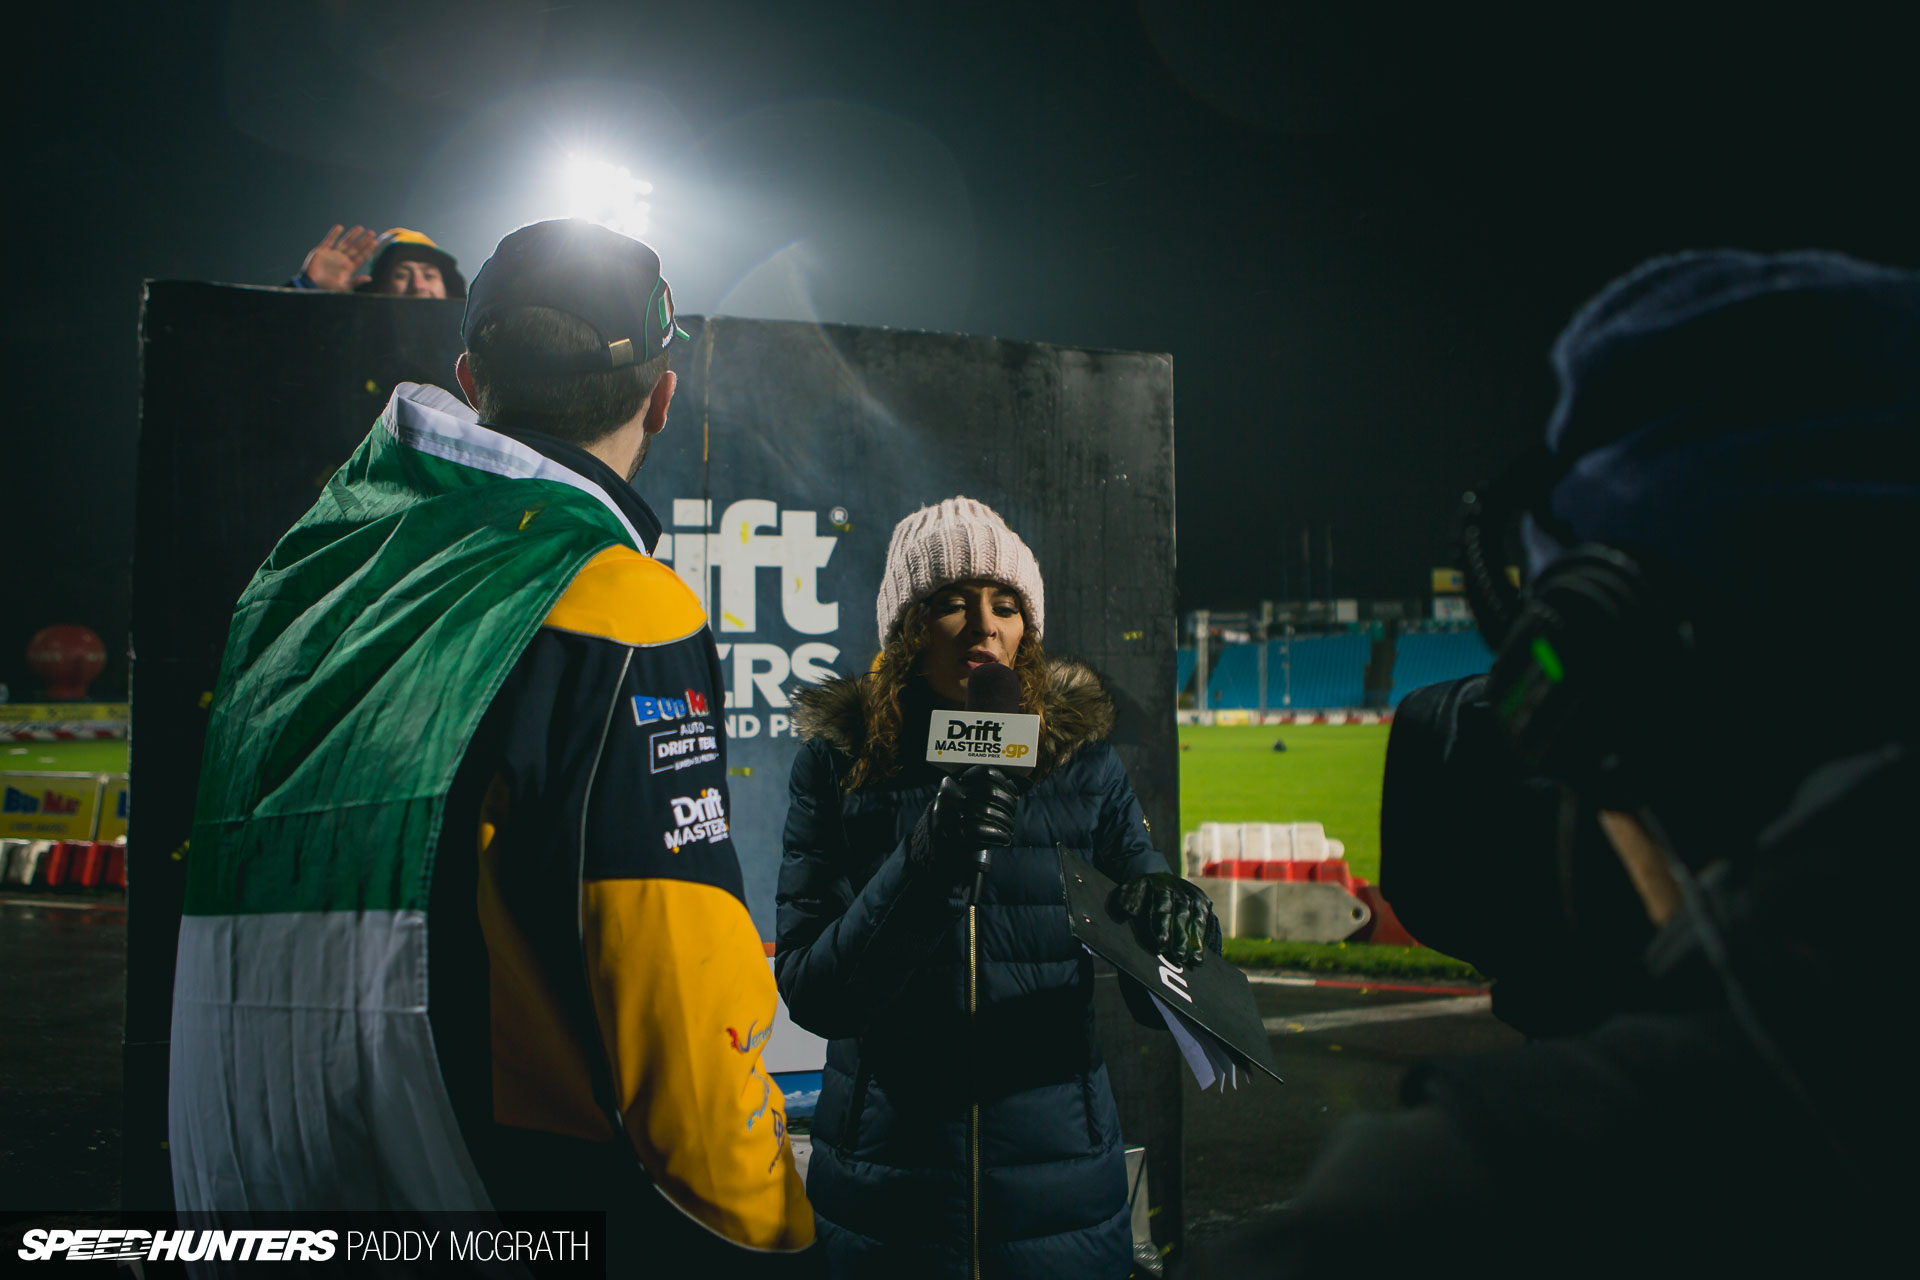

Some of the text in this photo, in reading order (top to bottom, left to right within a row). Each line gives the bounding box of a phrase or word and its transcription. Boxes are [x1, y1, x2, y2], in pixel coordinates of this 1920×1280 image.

[652, 499, 839, 635] ift
[680, 721, 705, 736] AUTO
[947, 719, 1003, 742] Drift
[657, 738, 696, 758] DRIFT
[670, 787, 725, 828] Drift
